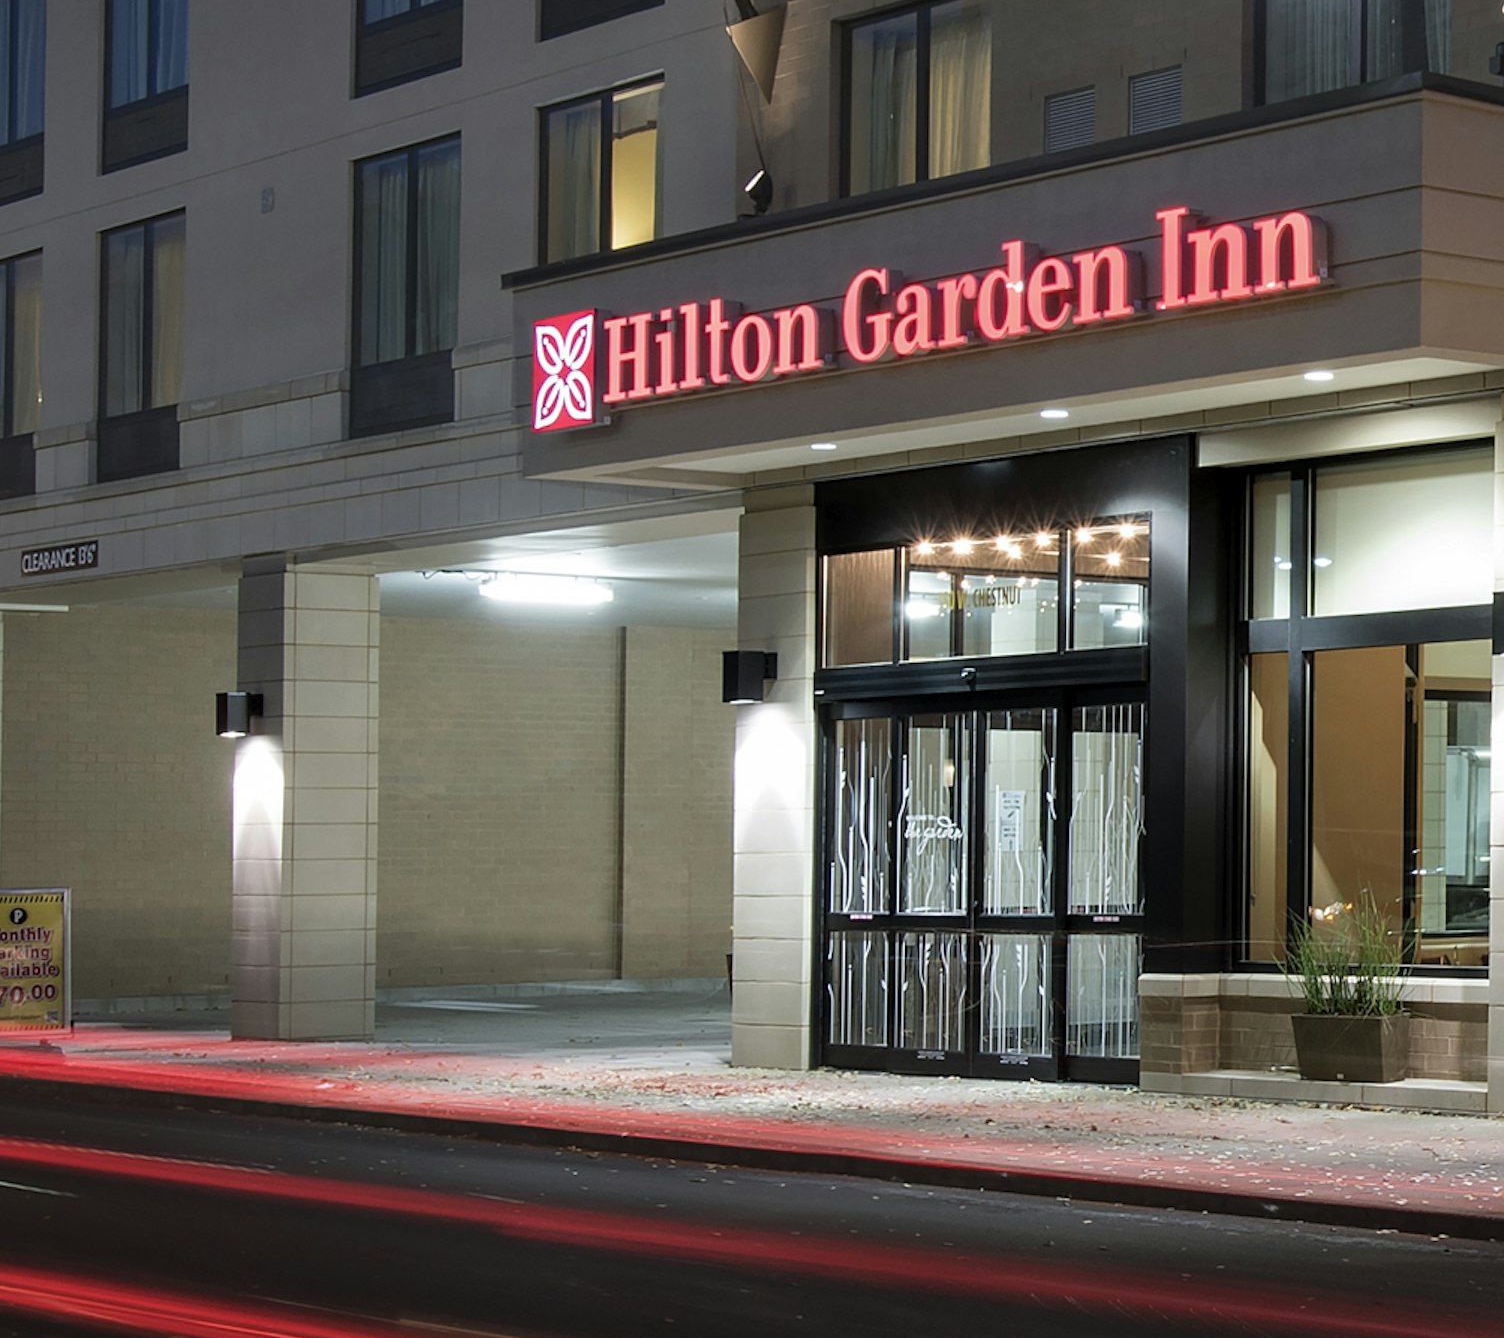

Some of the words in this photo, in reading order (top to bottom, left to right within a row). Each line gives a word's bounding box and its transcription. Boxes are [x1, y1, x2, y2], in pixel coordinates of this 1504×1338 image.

[602, 297, 823, 404] Hilton
[842, 239, 1134, 363] Garden
[1154, 205, 1322, 311] Inn
[22, 548, 76, 573] CLEARANCE
[972, 585, 1022, 608] CHESTNUT
